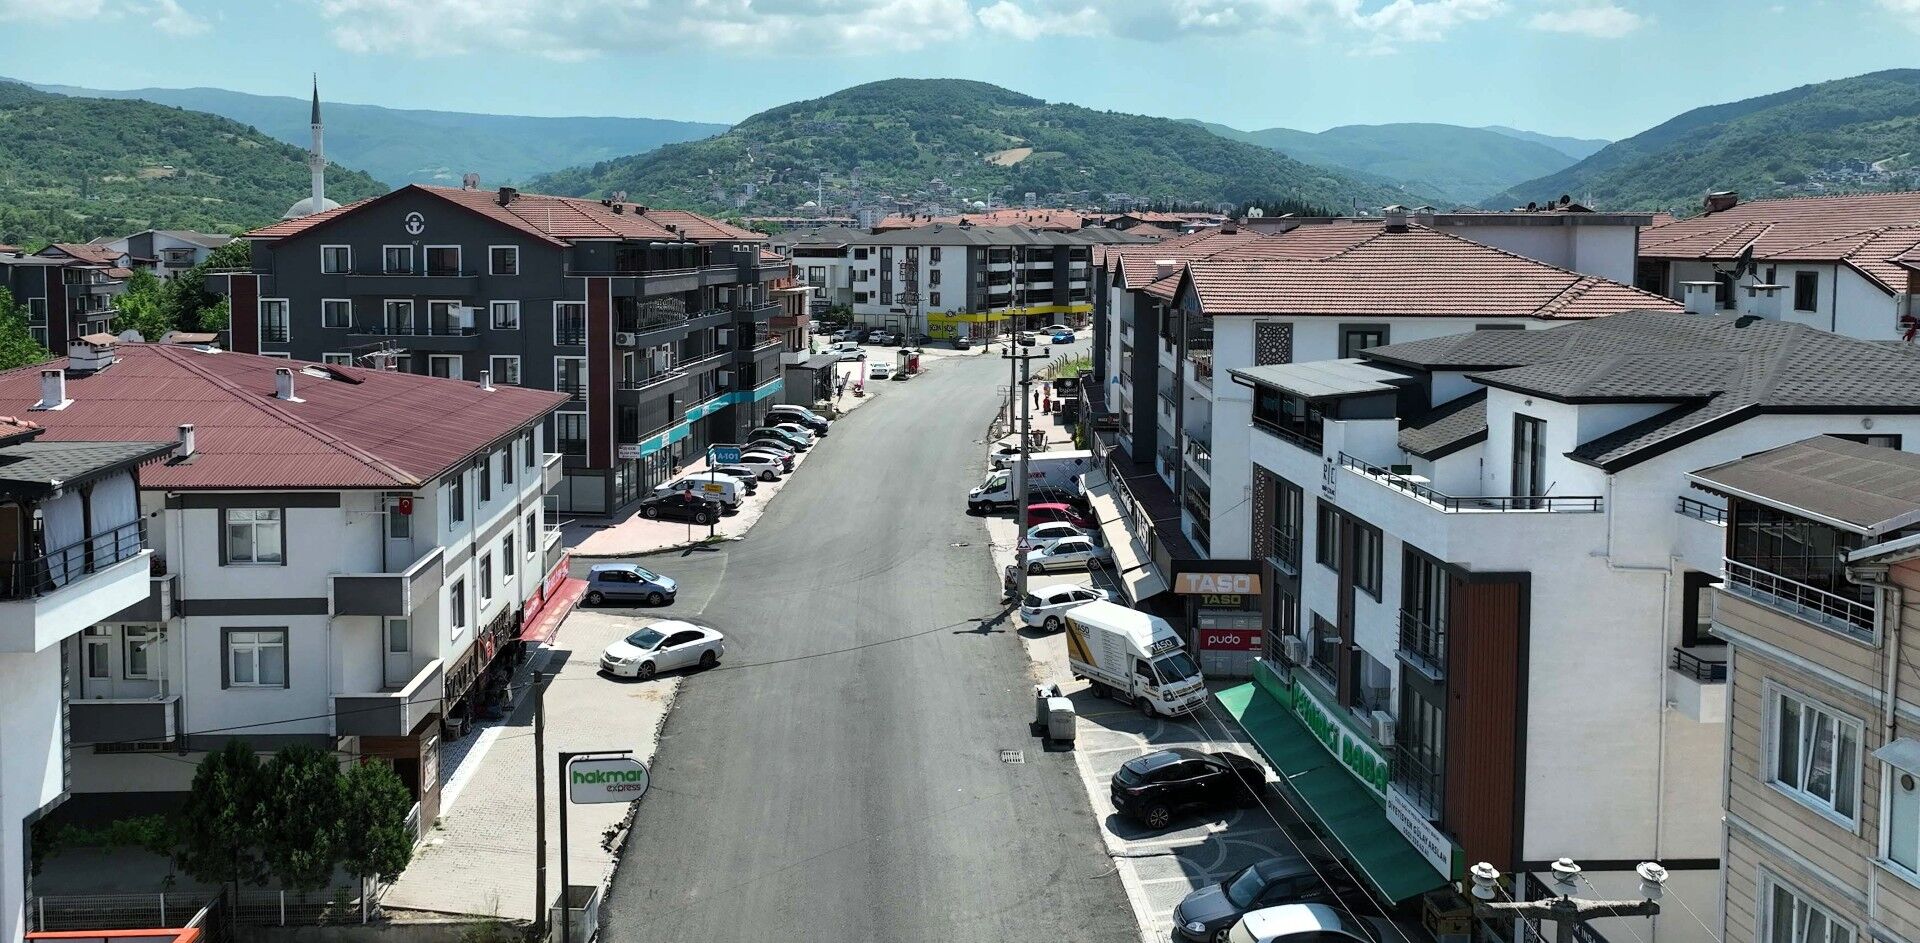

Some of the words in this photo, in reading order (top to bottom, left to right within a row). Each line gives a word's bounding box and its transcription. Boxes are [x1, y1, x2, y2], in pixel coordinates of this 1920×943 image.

[717, 452, 739, 460] A-101
[1186, 574, 1250, 593] TASO
[1202, 595, 1241, 605] TASO
[1074, 622, 1090, 634] TASO
[1151, 639, 1174, 652] TASO
[1208, 633, 1241, 646] pudo
[1343, 733, 1388, 796] BABA
[573, 769, 643, 784] hakmar
[606, 783, 641, 792] express
